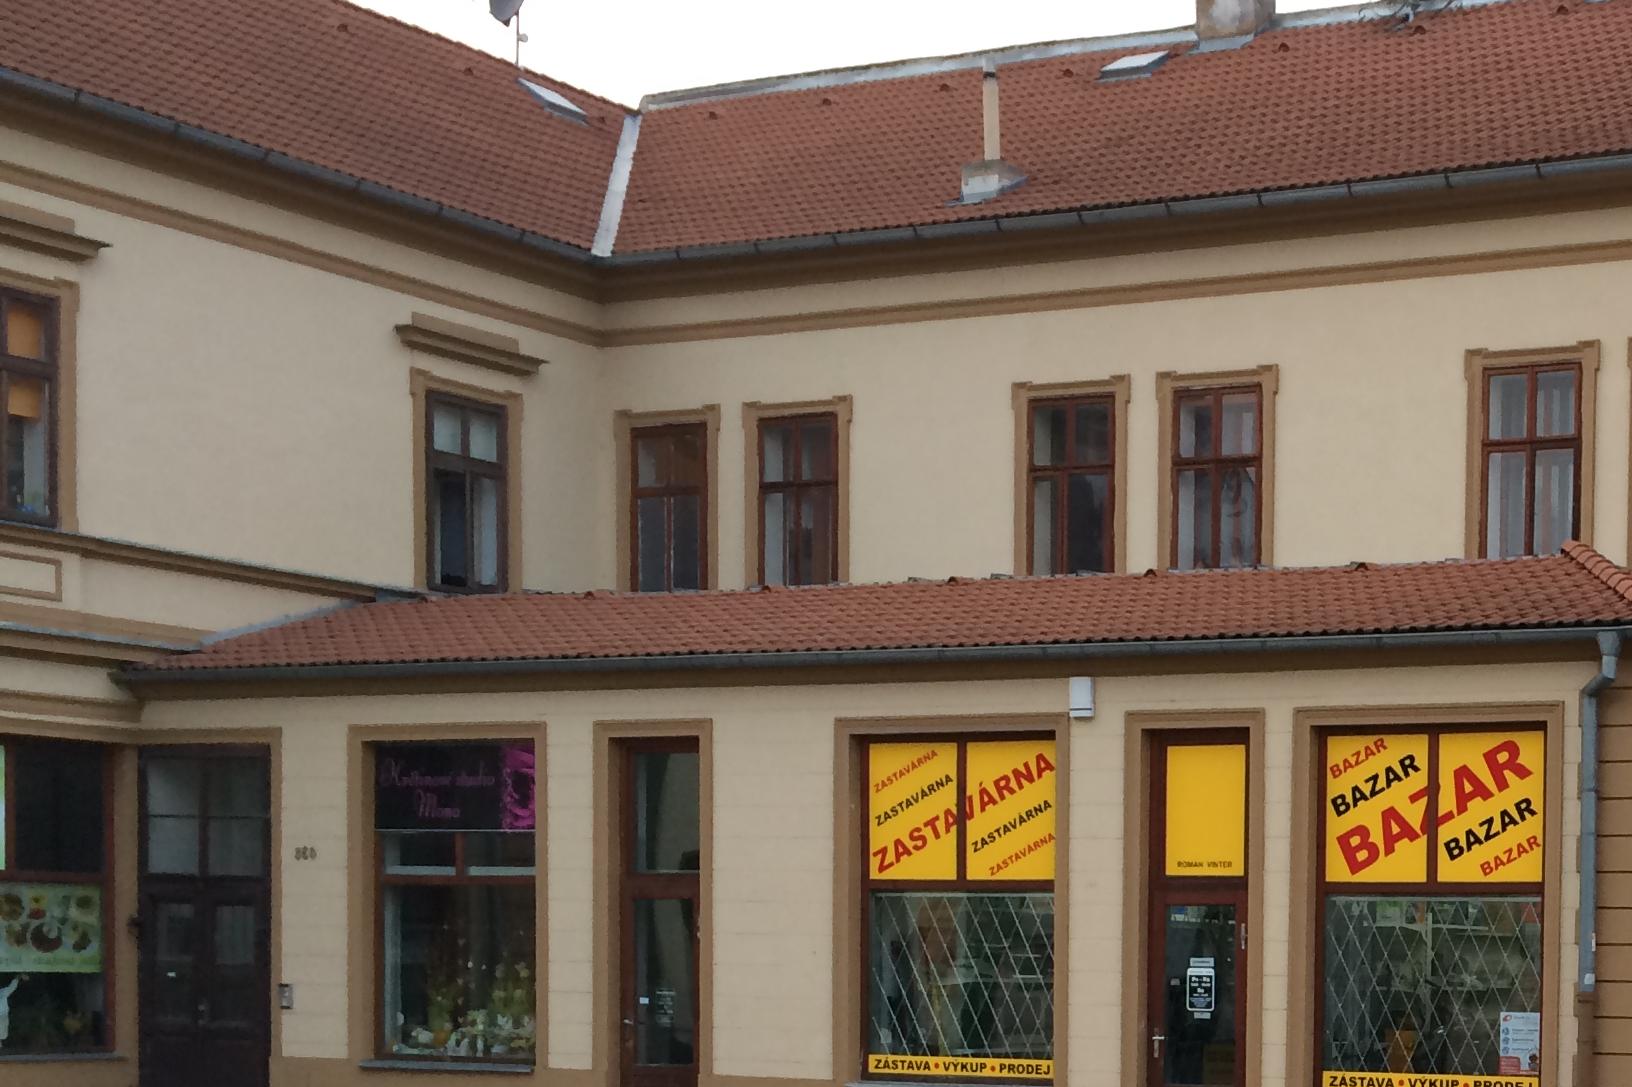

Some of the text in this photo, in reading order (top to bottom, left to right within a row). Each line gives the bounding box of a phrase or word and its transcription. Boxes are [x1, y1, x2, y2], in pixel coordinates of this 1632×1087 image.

[874, 750, 938, 794] ZASTAVÁRNA
[1329, 737, 1388, 779] BAZAR
[875, 774, 954, 827] ZASTAVÁRNA
[1330, 754, 1422, 818] BAZAR
[1336, 739, 1534, 876] BAZAR
[873, 752, 1056, 874] ZASTAVÁRNA
[971, 800, 1053, 853] ZASTAVÁRNA
[1443, 797, 1539, 862] BAZAR
[988, 833, 1056, 876] ZASTAVÁRNA
[1480, 835, 1541, 877] BAZAR
[874, 1057, 1051, 1075] ZÁSTAVA VÝKUP PRODEJ
